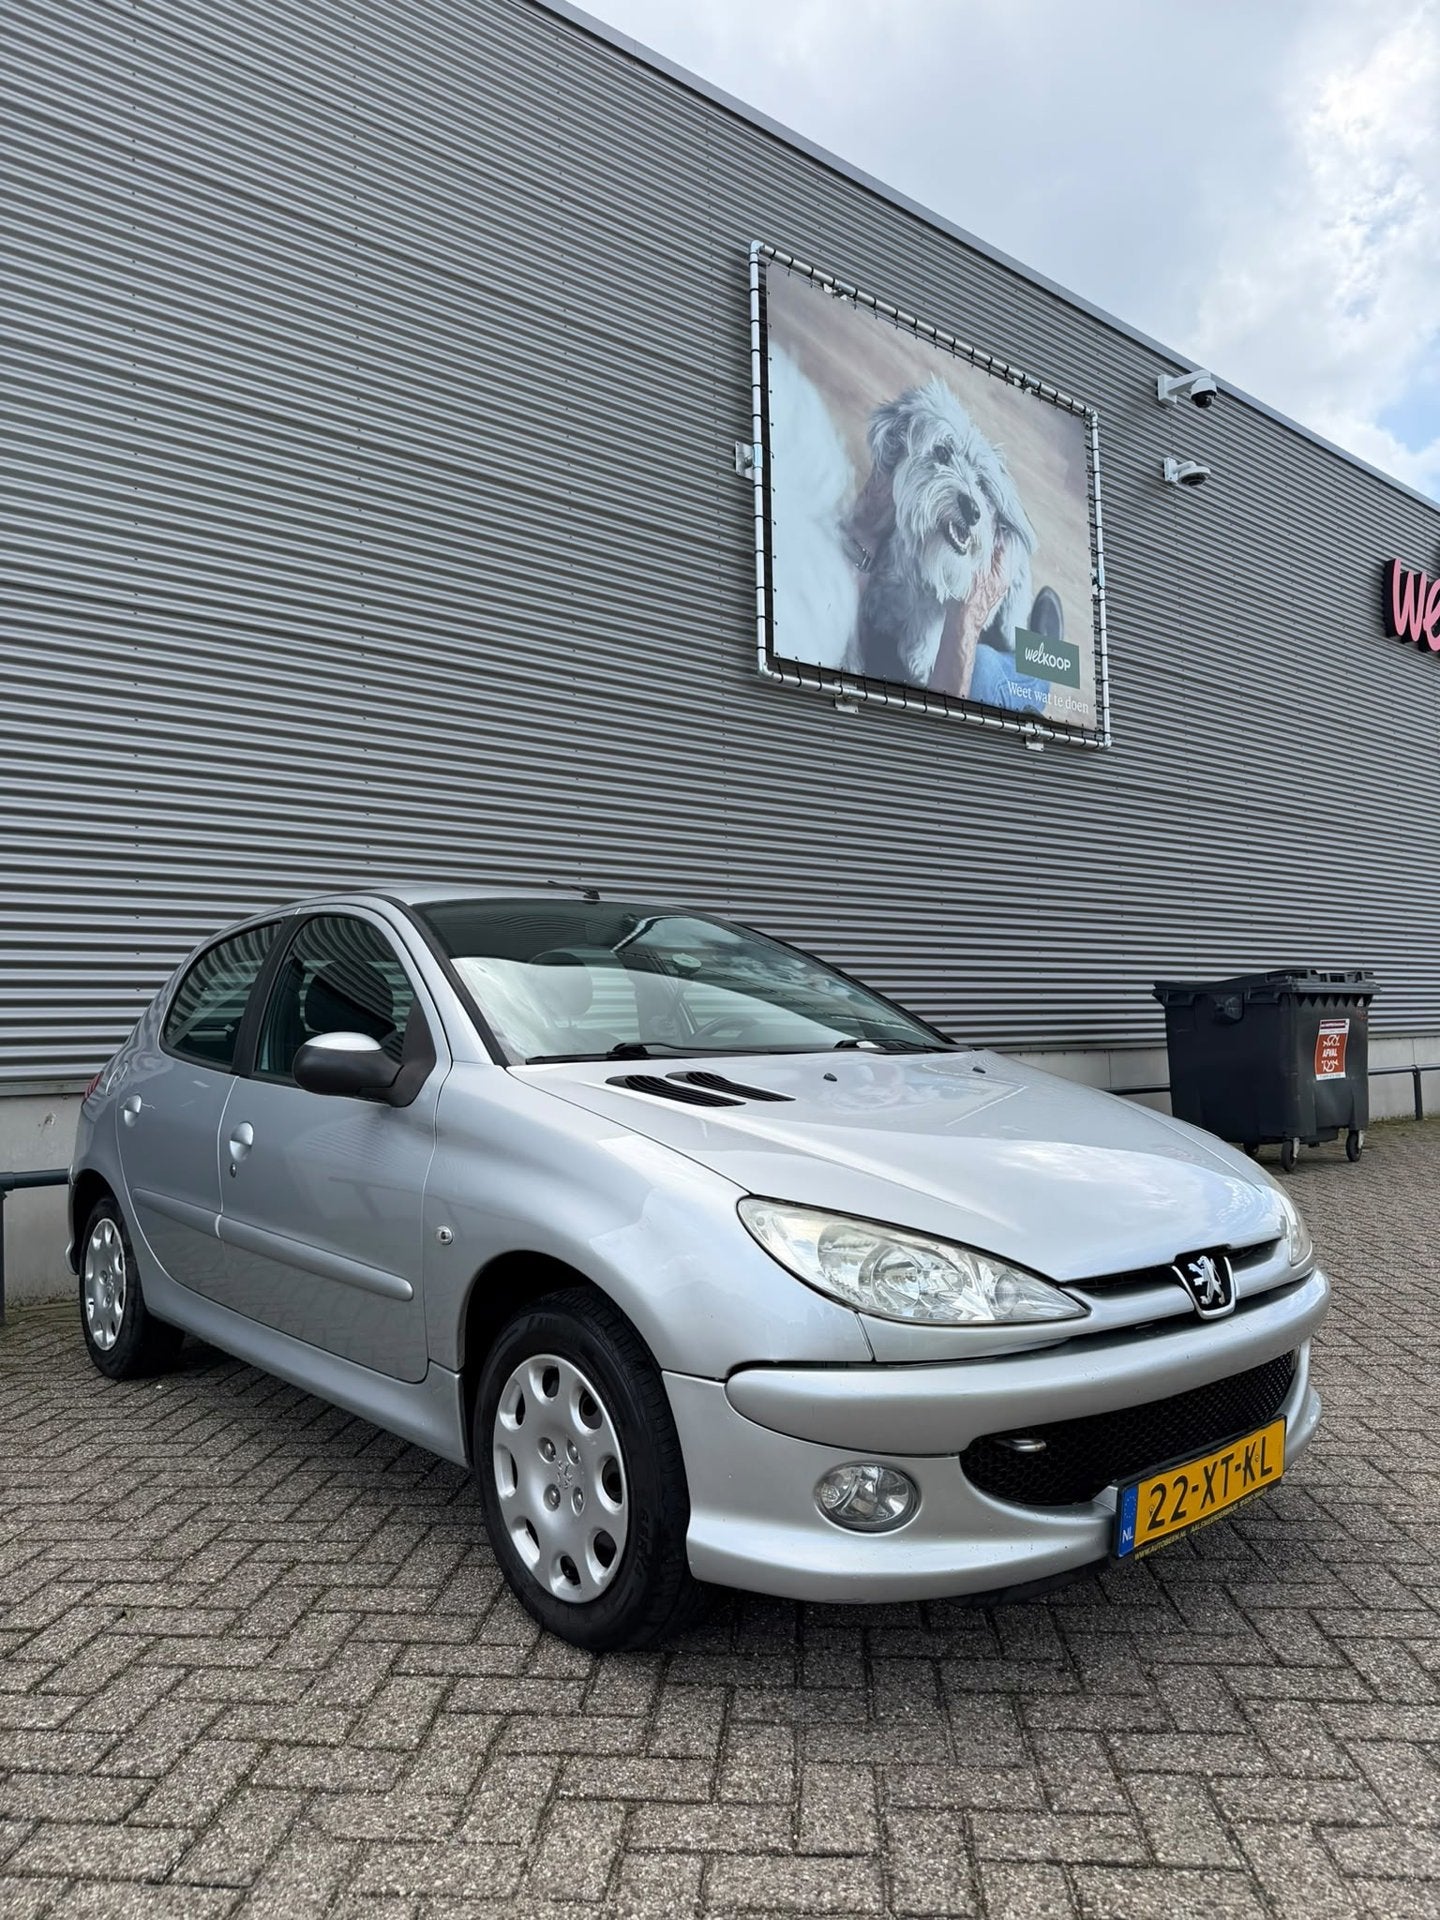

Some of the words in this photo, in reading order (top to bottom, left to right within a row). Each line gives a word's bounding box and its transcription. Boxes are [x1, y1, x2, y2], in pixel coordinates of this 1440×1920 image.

[1007, 681, 1032, 700] Weet
[1034, 690, 1051, 705] wat
[1053, 694, 1064, 707] te
[1065, 696, 1089, 714] doen
[1322, 1048, 1338, 1057] AFVAL
[1147, 1436, 1273, 1531] 22-XT-KL
[1121, 1526, 1134, 1543] NL
